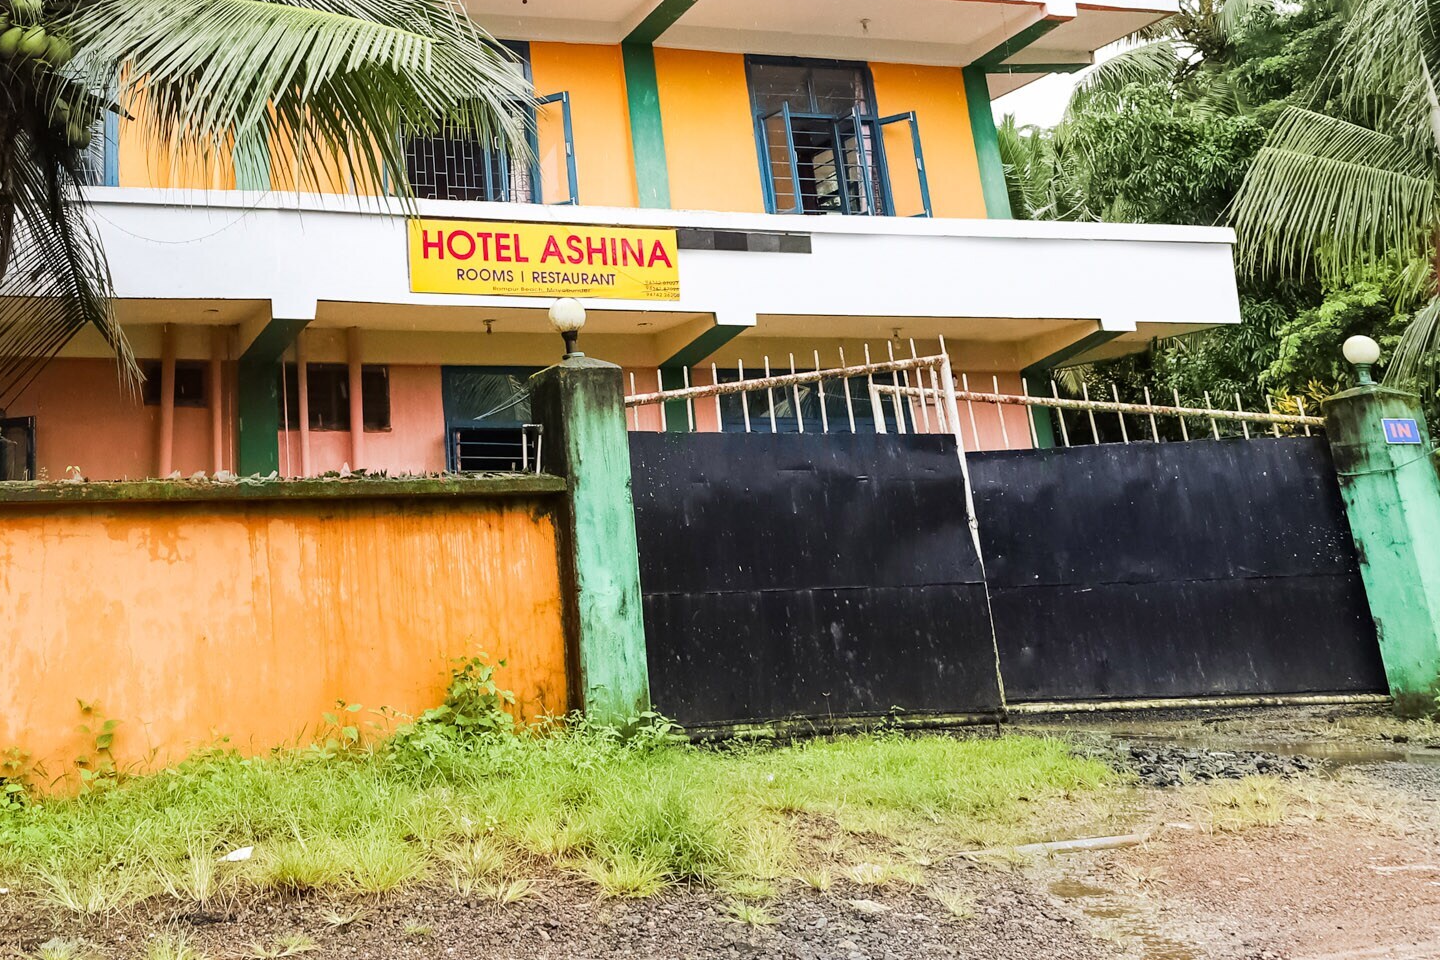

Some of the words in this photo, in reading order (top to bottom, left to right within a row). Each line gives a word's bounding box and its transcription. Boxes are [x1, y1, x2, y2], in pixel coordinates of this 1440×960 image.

[422, 229, 529, 263] HOTEL
[540, 234, 673, 269] ASHINA
[456, 268, 514, 282] ROOMS
[532, 271, 616, 286] RESTAURANT
[1389, 423, 1412, 438] IN
